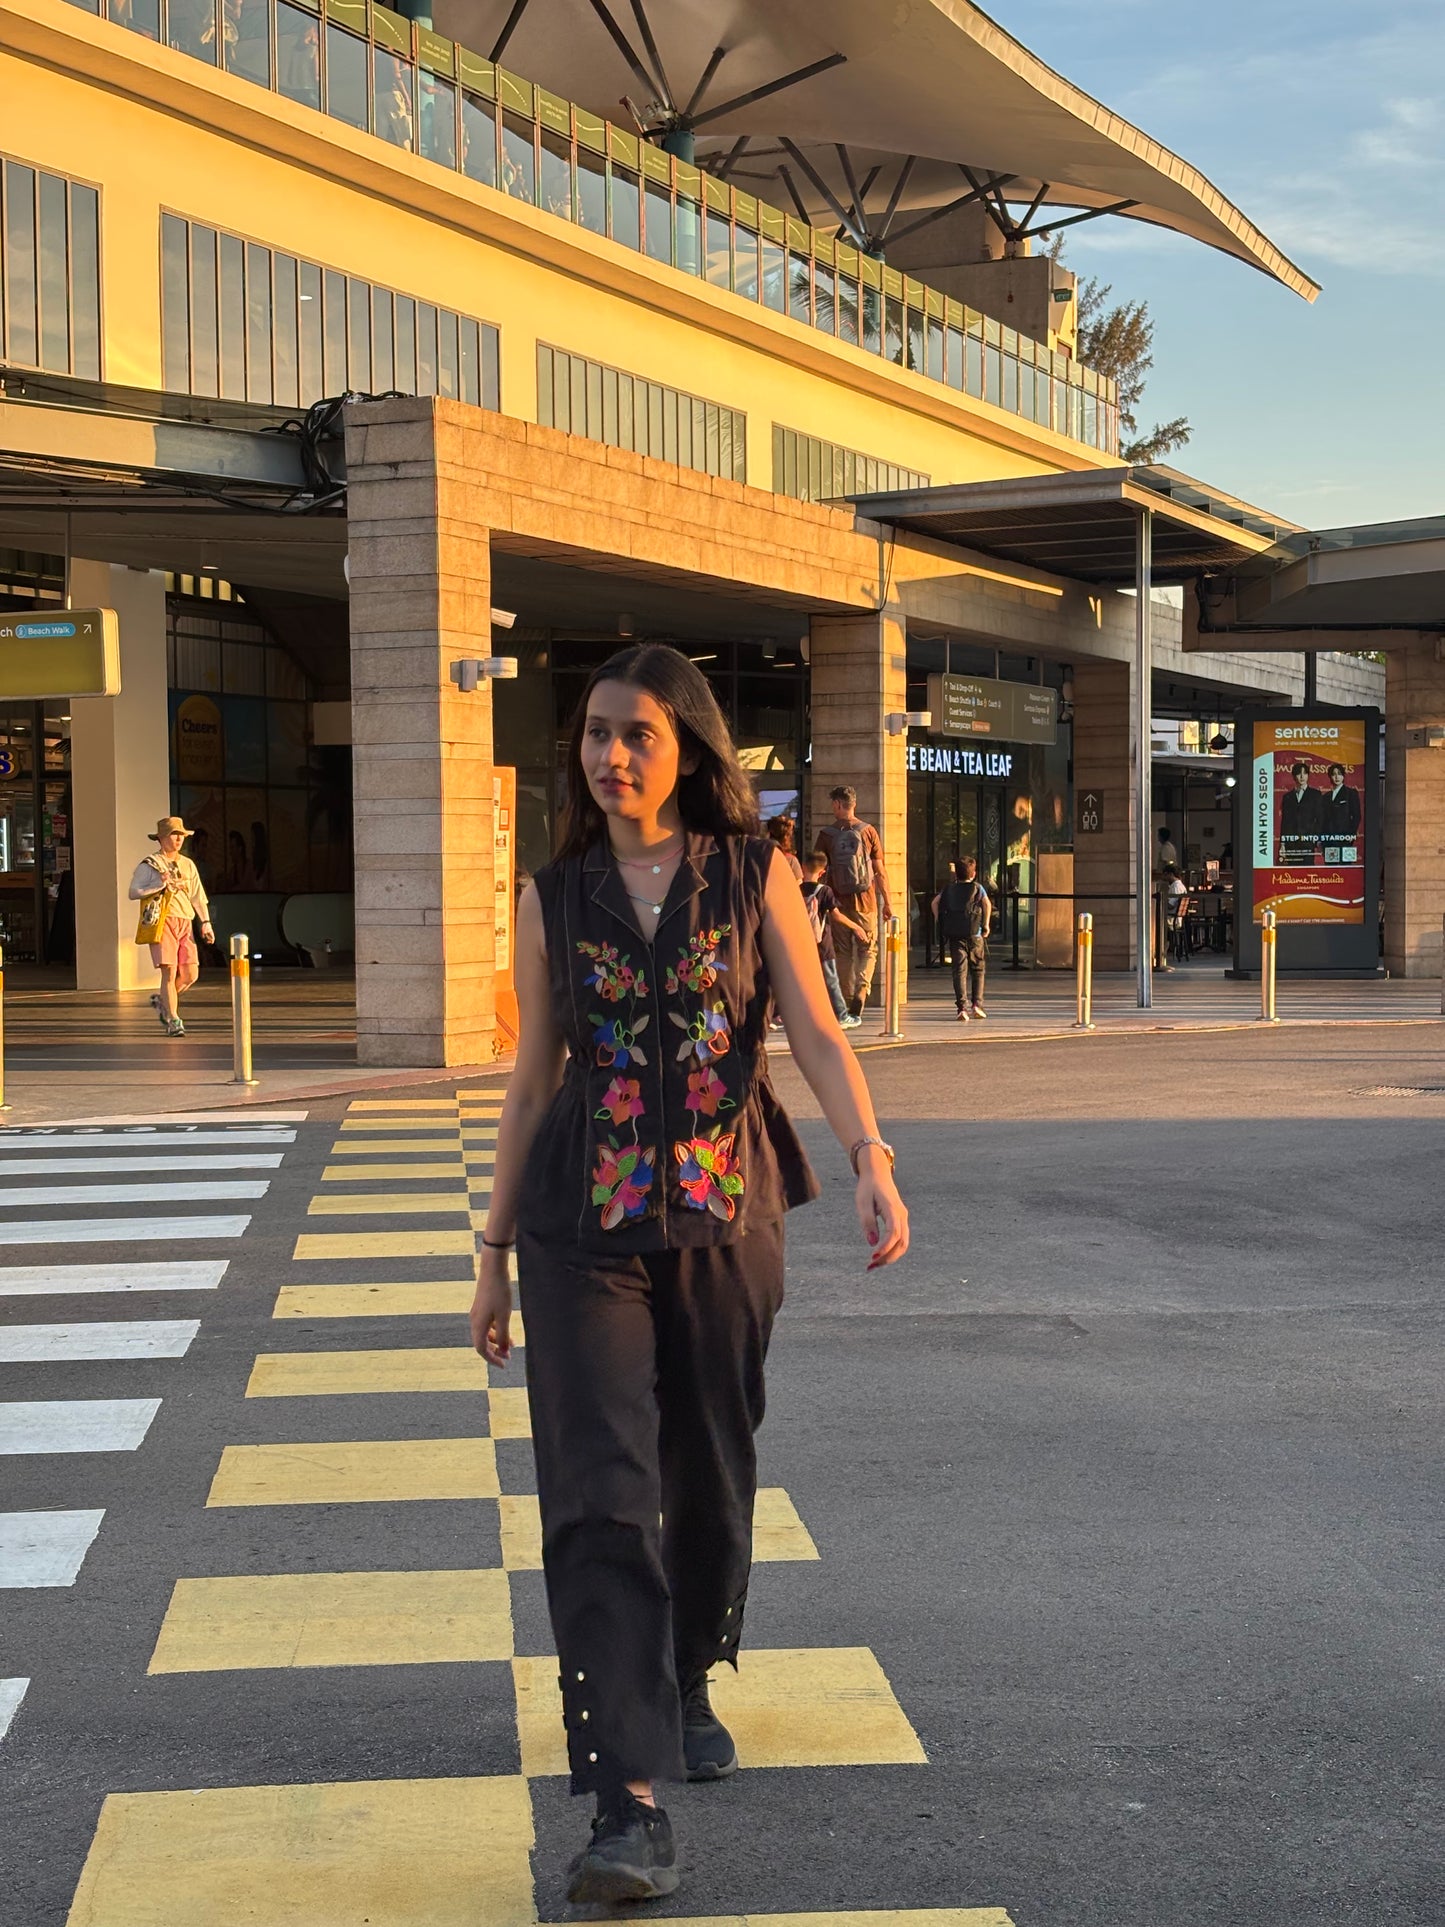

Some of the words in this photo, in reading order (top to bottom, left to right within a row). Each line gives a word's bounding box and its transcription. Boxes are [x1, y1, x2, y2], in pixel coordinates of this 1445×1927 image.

[27, 627, 50, 635] Beach
[51, 626, 70, 634] Walk
[182, 718, 217, 735] Cheers
[1275, 726, 1338, 739] sentosa
[920, 747, 951, 773] BEAN
[962, 751, 983, 775] TEA
[986, 753, 1012, 777] LEAF
[1259, 768, 1268, 799] SEOP
[1259, 802, 1268, 828] HYO
[1259, 831, 1268, 856] AHN
[1320, 834, 1357, 842] STARDOM
[1272, 872, 1309, 885] Madame
[1307, 873, 1344, 884] Tussauds
